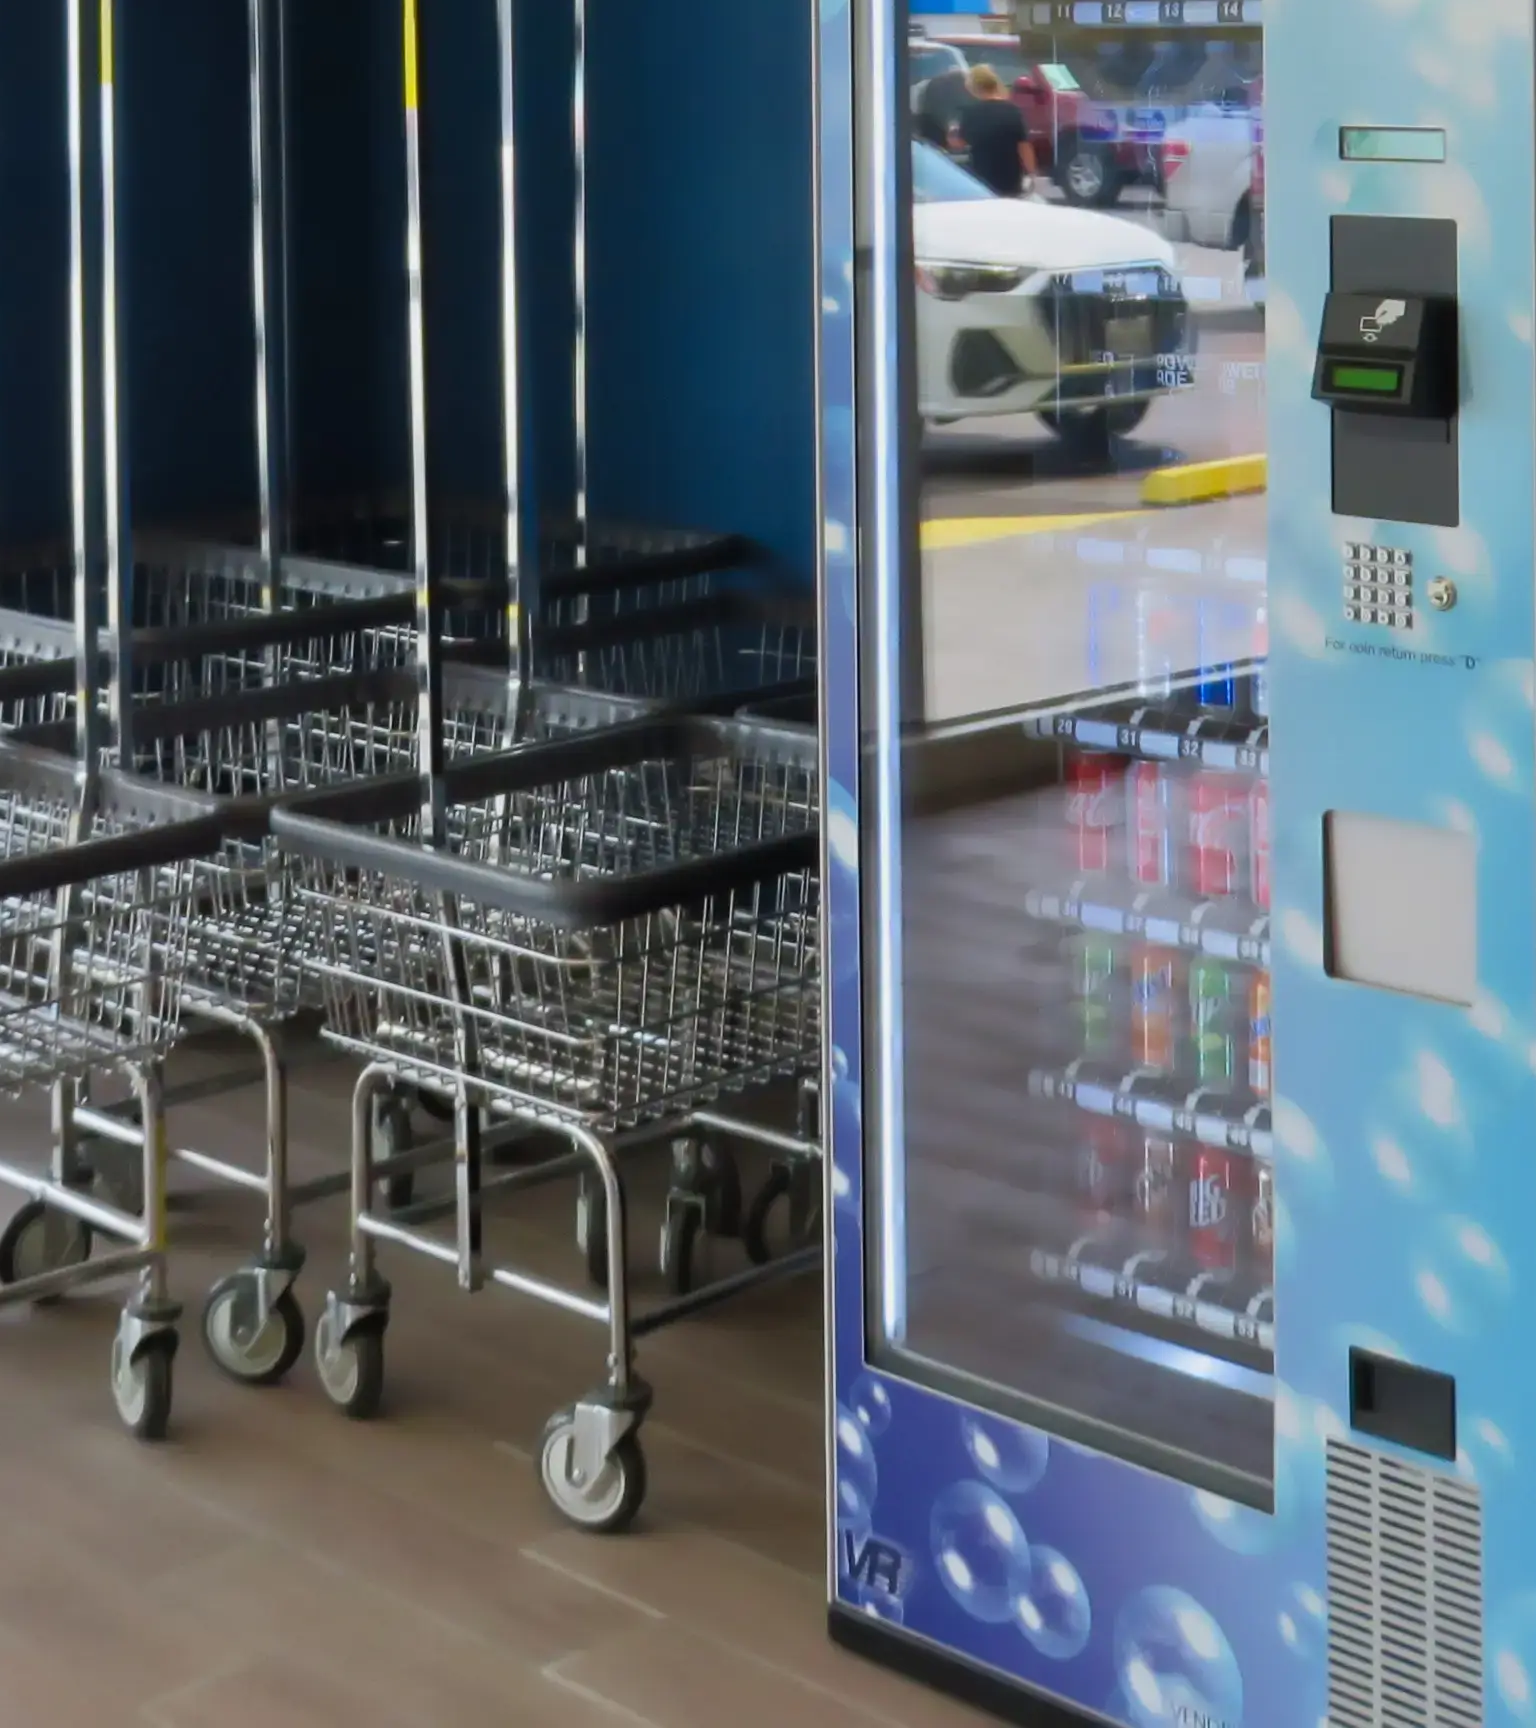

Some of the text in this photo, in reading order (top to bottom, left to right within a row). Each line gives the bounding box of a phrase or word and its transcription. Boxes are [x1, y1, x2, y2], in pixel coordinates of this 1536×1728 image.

[1107, 3, 1122, 18] 12
[1164, 2, 1179, 17] 13
[1222, 1, 1238, 17] 14
[1119, 728, 1136, 746] 31
[1181, 740, 1199, 756] 32
